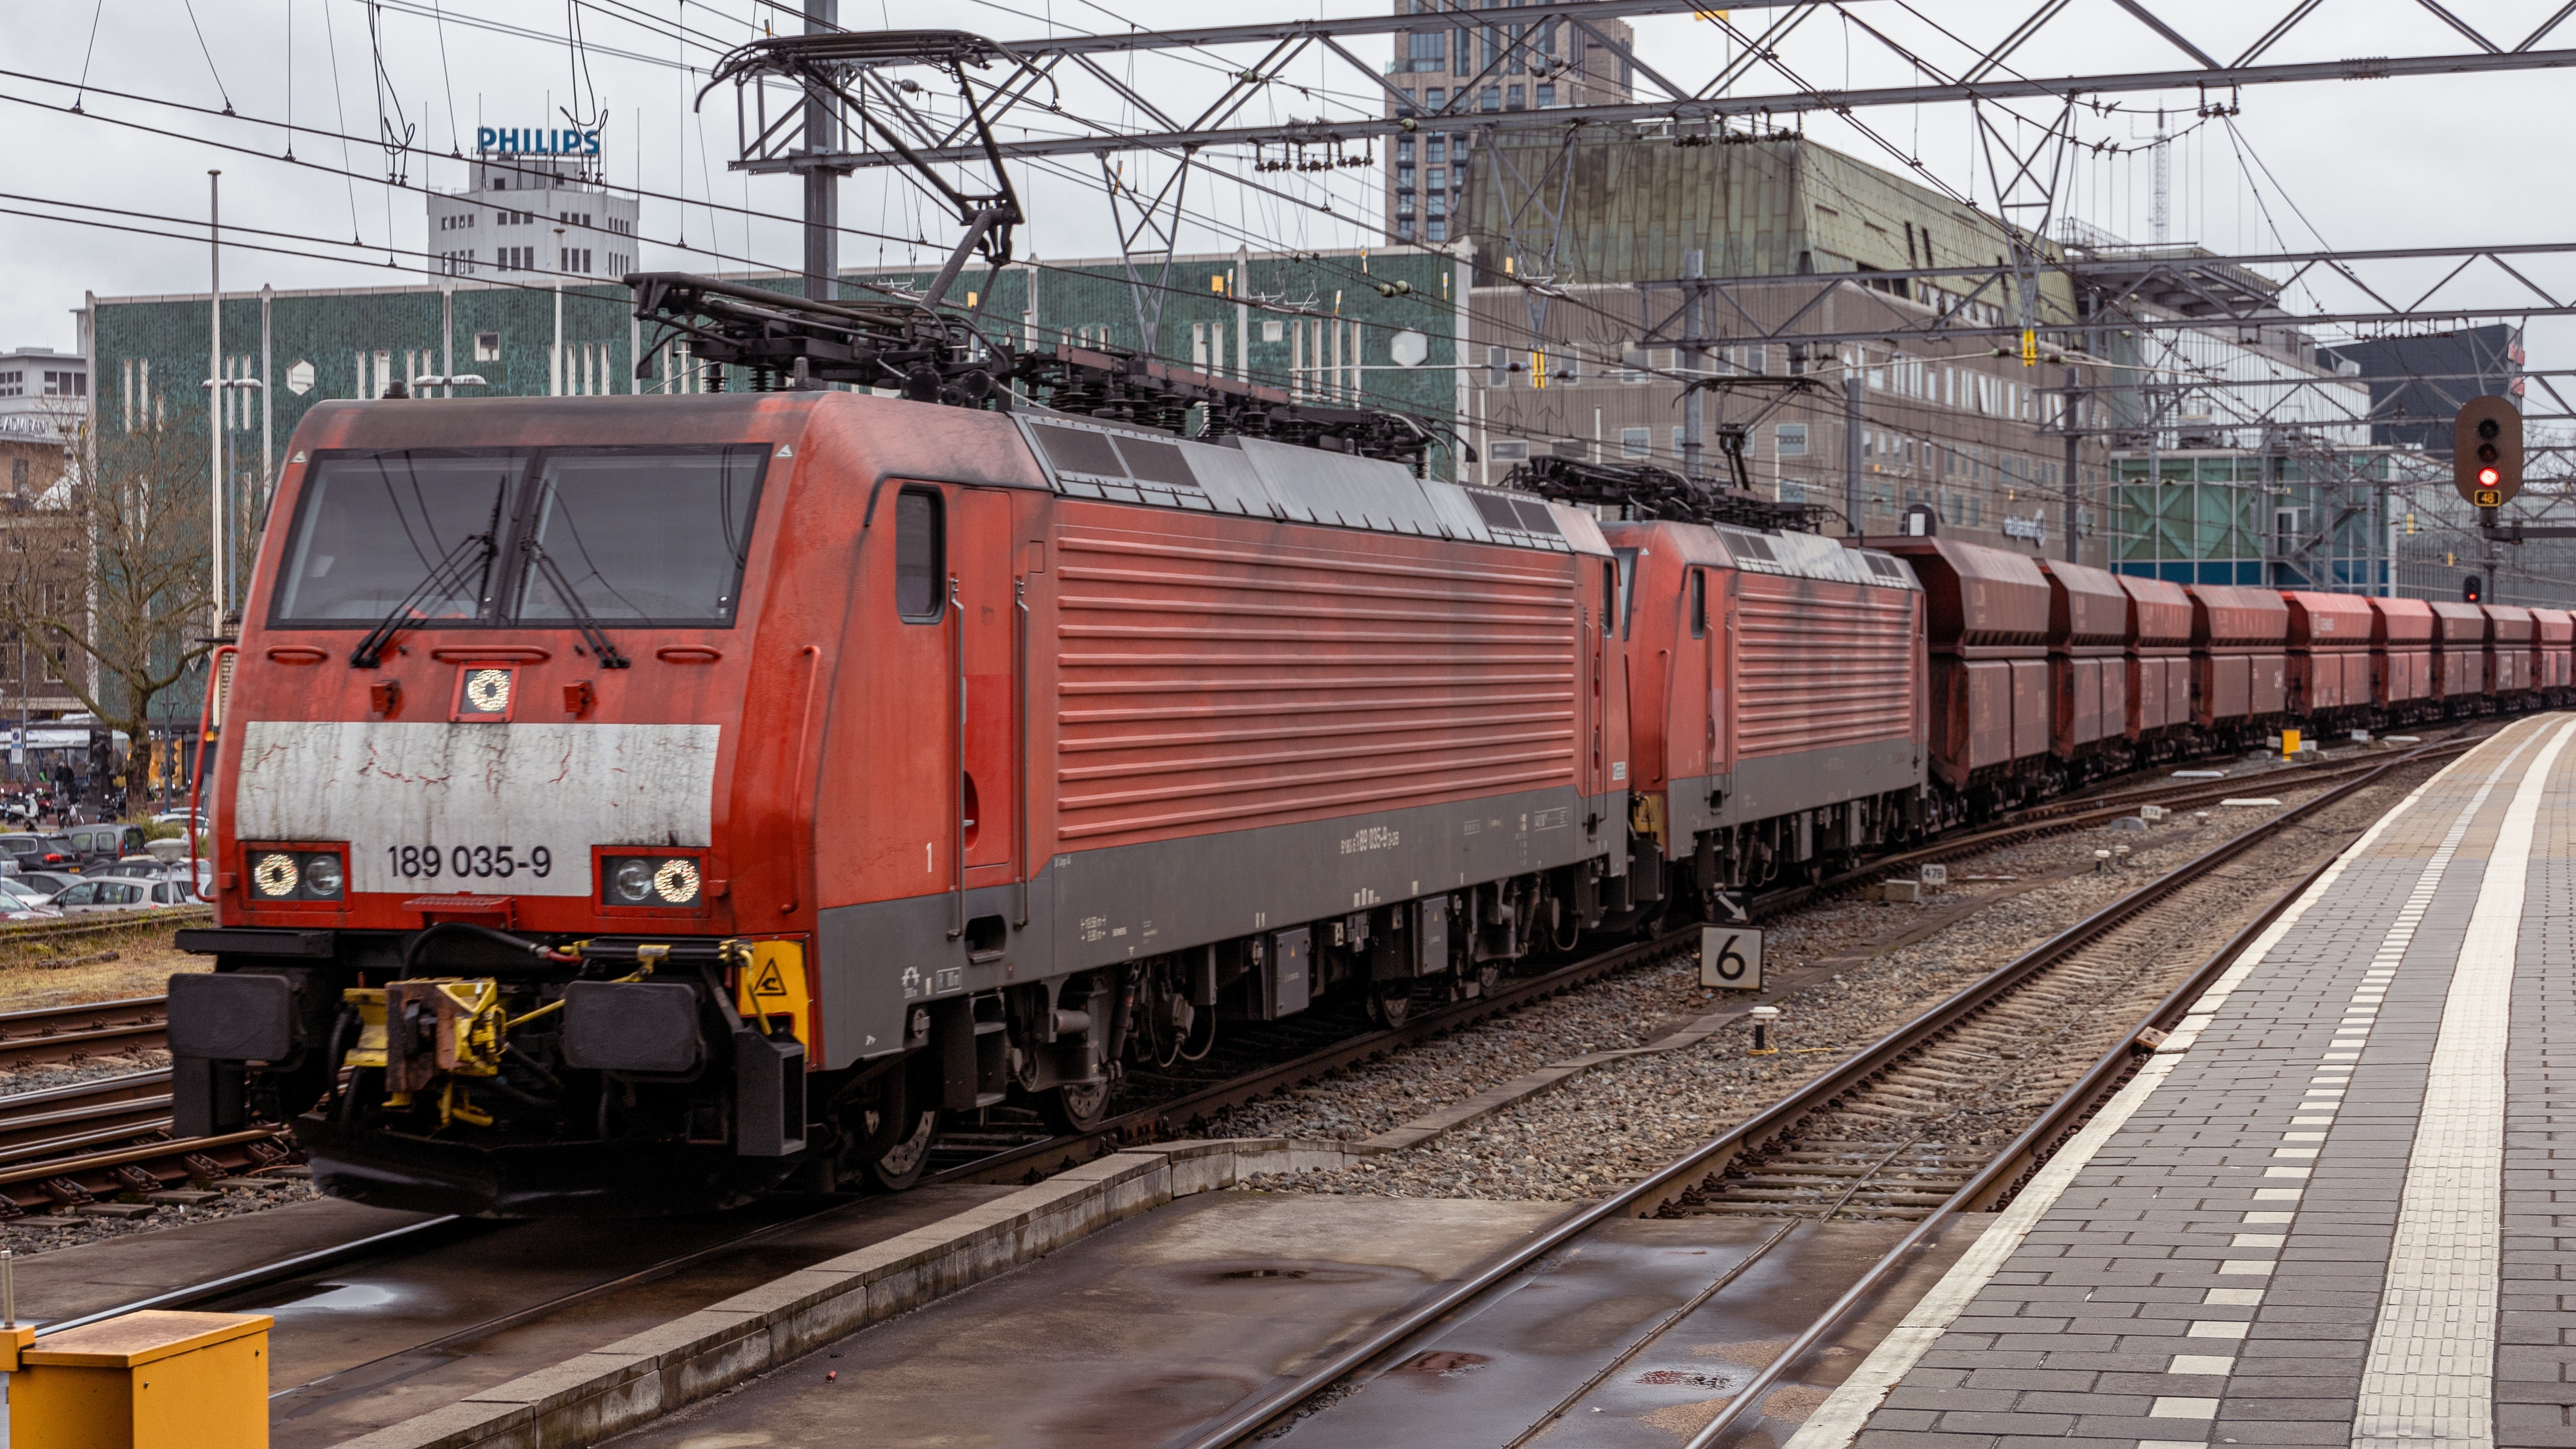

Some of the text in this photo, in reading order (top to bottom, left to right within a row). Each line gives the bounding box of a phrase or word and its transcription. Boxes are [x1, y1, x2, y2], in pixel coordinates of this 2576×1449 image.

[478, 127, 599, 154] PHILIPS
[3, 416, 49, 433] ADMIRANT
[2480, 492, 2495, 504] 48
[387, 845, 552, 878] 189 035-9
[1716, 934, 1746, 980] 6
